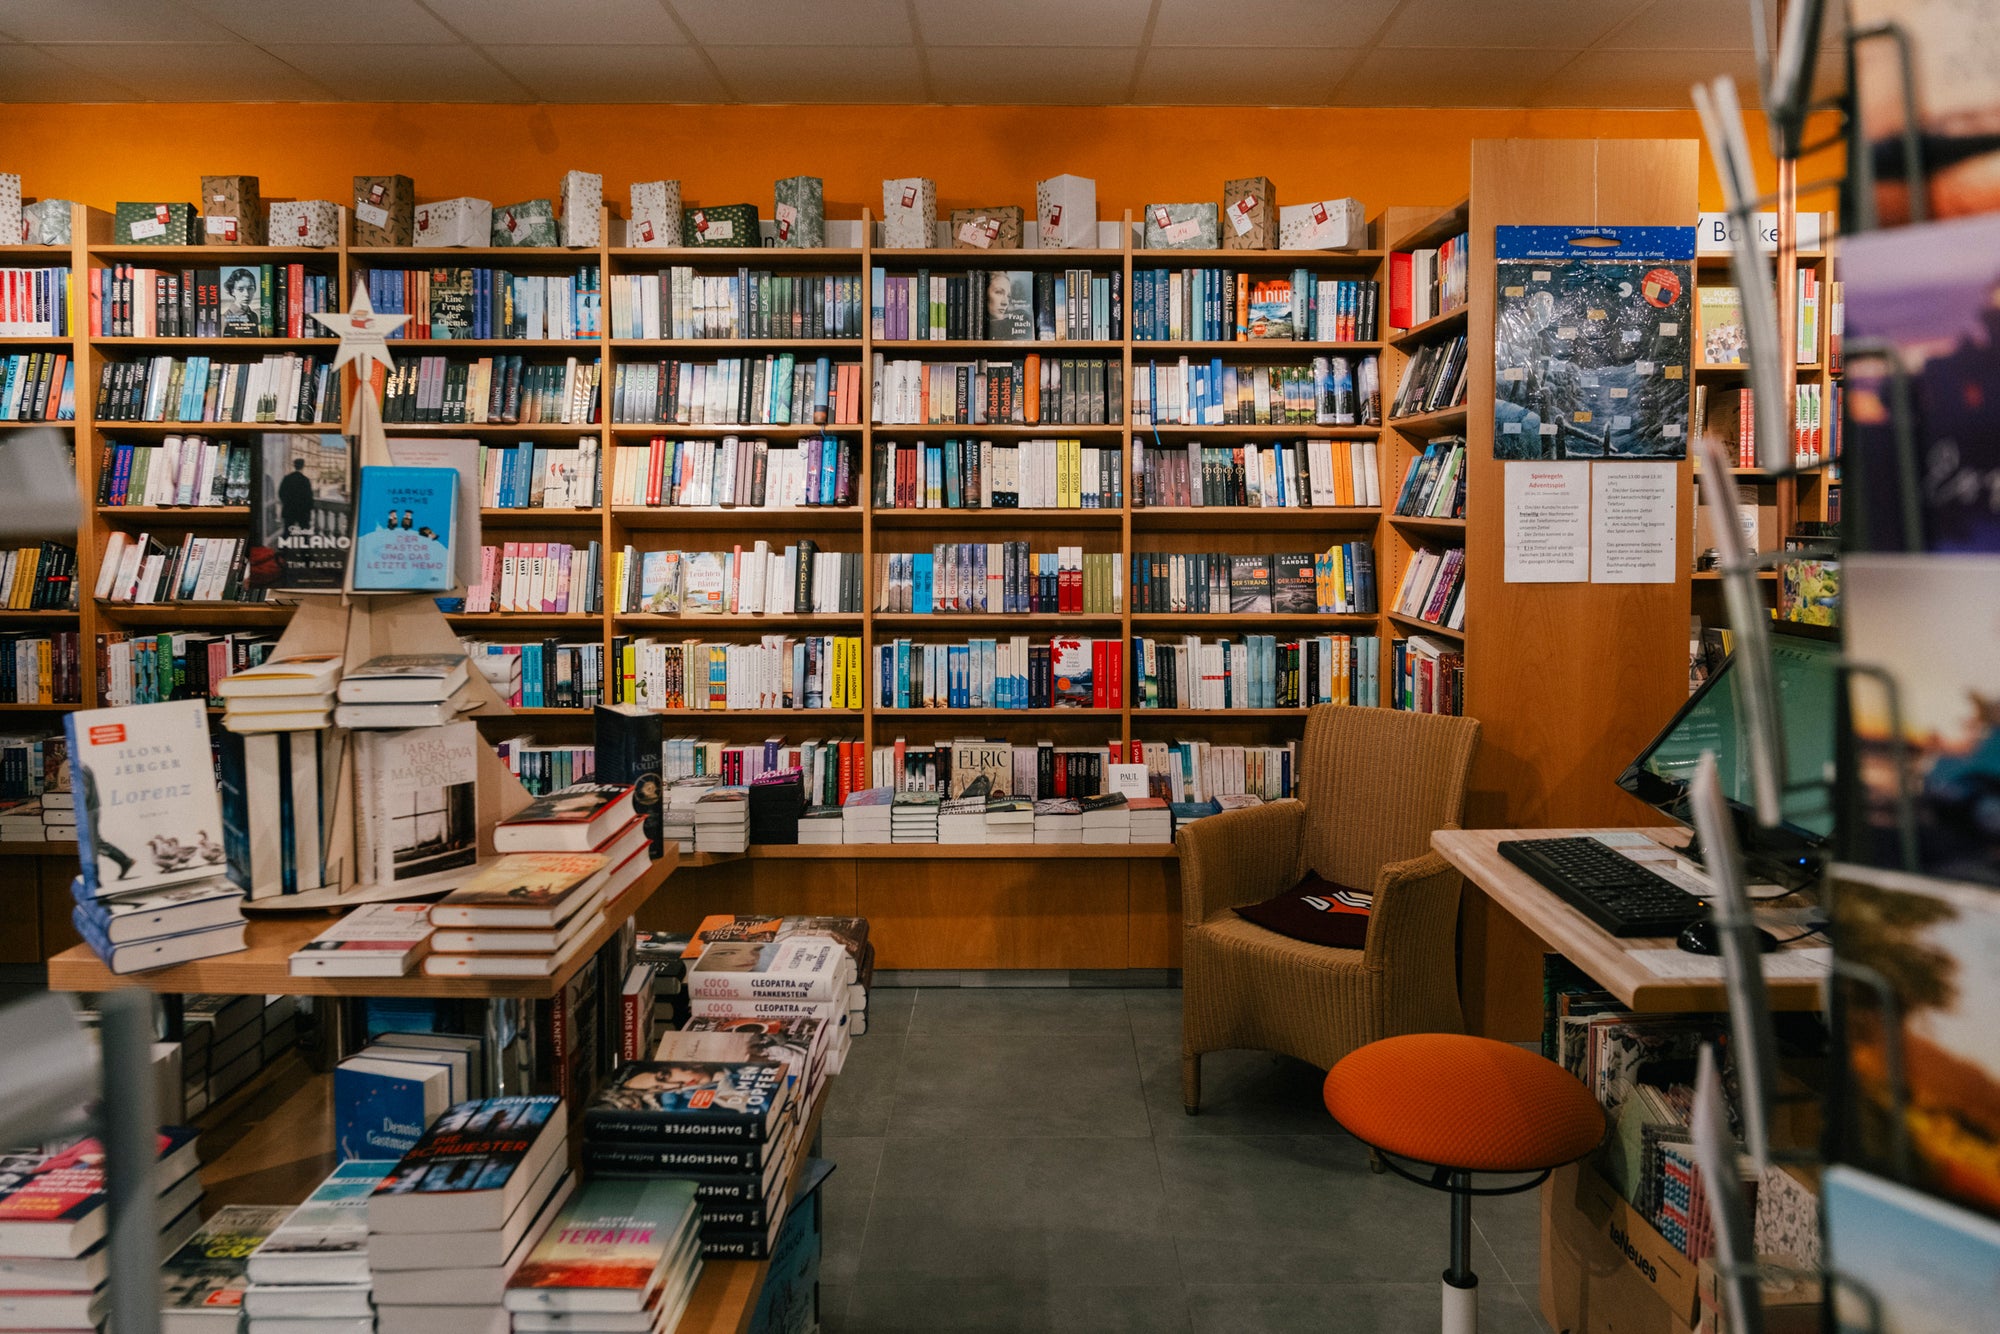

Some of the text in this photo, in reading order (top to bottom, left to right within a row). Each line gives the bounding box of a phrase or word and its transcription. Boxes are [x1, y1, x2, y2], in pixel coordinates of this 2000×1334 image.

[1714, 221, 1779, 242] Bake
[198, 285, 207, 305] LIAR
[209, 285, 217, 305] LIAR
[1225, 276, 1233, 305] THEATER
[442, 303, 465, 312] Frage
[438, 319, 467, 327] Chemie
[1008, 313, 1024, 322] Frag
[1011, 327, 1026, 335] Jane
[7, 359, 17, 388] NACHT
[302, 382, 310, 405] DEAVER
[958, 377, 966, 404] FOLLOWER
[990, 378, 998, 412] Rabbits
[1001, 377, 1010, 412] Rabbits
[123, 450, 131, 476] BLUTBUCH
[278, 535, 351, 549] MILANO
[367, 561, 407, 569] LETZTE
[118, 745, 174, 760] ILONA
[959, 750, 1007, 770] ELRIC
[114, 759, 181, 776] JERGER
[110, 781, 192, 807] Lorenz
[695, 989, 739, 997] MELLORS
[704, 979, 814, 991] COCO CLEOPATRA and
[708, 1003, 818, 1014] COCO CLEOPATRA and
[625, 1002, 633, 1061] DORIS KNEC
[382, 1117, 422, 1135] Dennis
[664, 1124, 742, 1135] DAMENOPFER
[405, 1141, 528, 1160] SCHWESTER
[661, 1154, 738, 1164] DAMENOPFER
[558, 1229, 656, 1244] TERAFIK
[1609, 1223, 1658, 1283] teNeues
